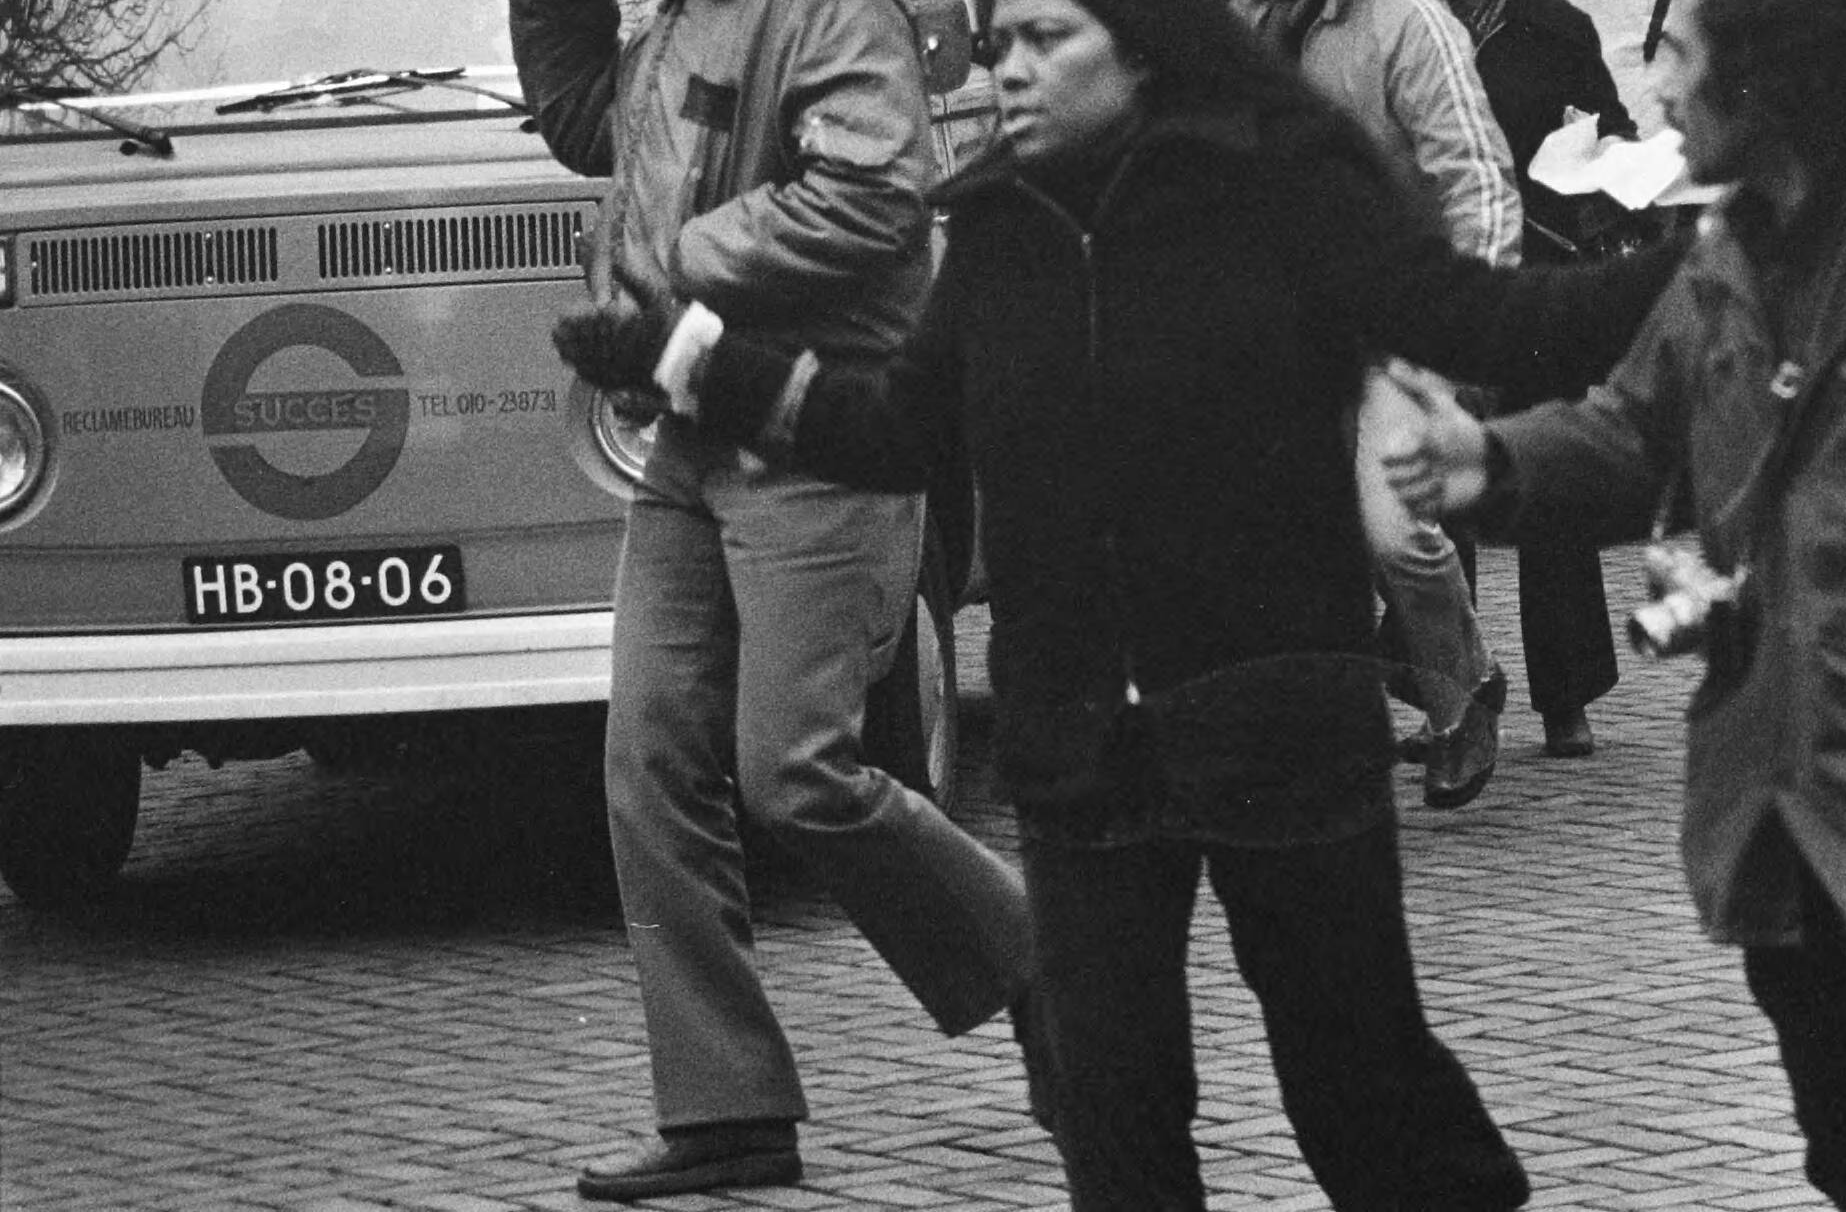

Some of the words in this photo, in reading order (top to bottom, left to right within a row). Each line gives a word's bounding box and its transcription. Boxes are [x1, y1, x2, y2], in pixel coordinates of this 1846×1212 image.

[62, 403, 196, 434] RECLAMEBUREAU
[233, 393, 377, 428] SUCCES
[192, 554, 453, 616] HB-08-06
